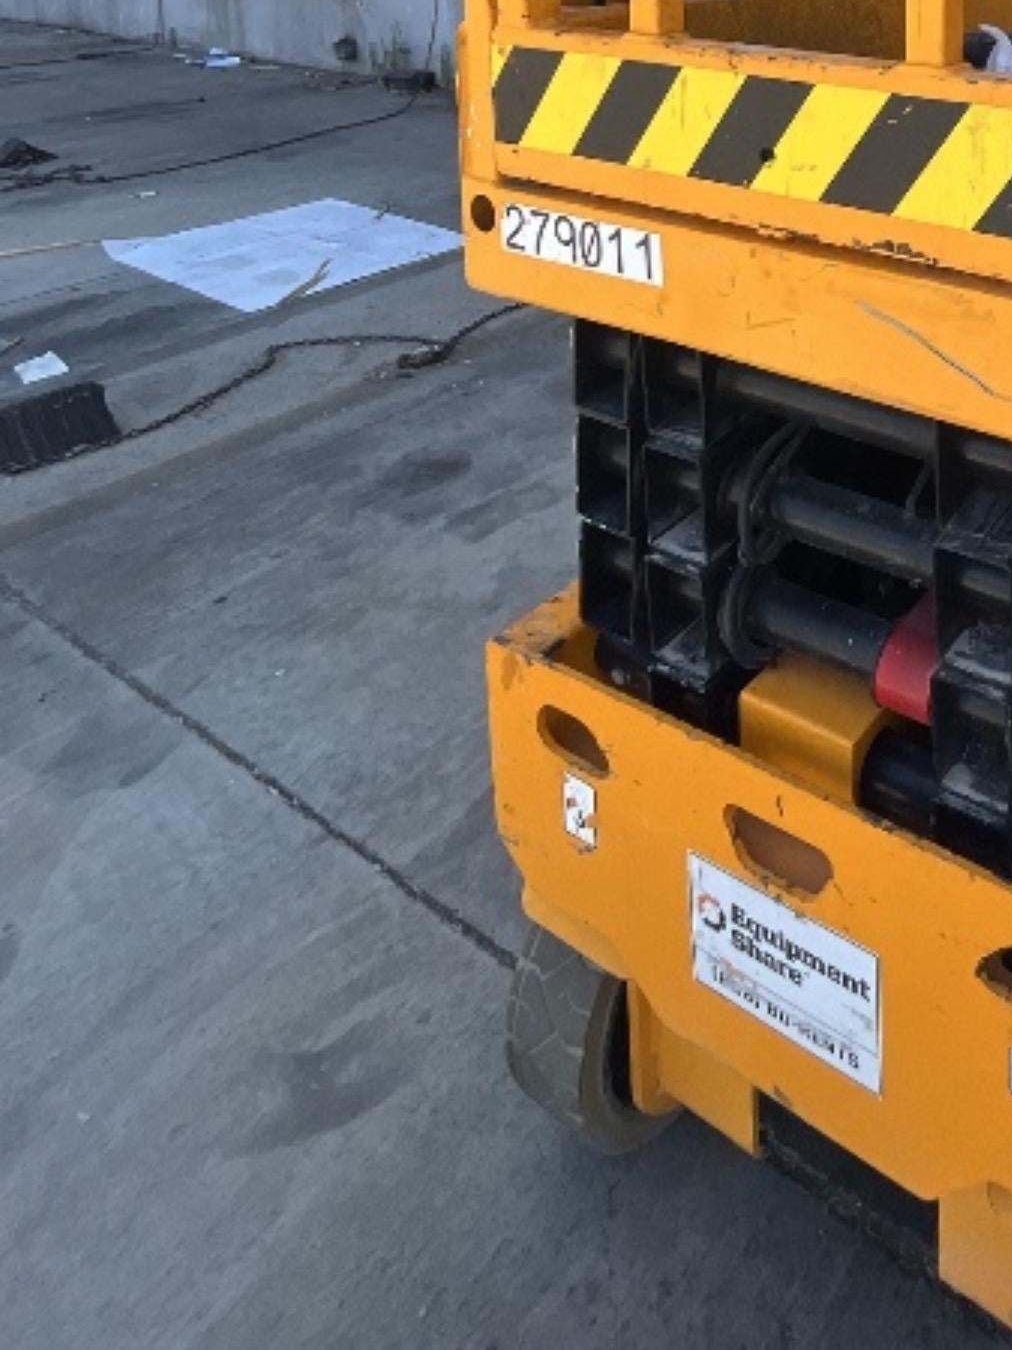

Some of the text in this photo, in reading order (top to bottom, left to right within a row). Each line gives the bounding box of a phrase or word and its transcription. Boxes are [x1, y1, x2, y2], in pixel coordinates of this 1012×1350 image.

[505, 205, 654, 280] 279011
[731, 902, 871, 1003] Equipment
[731, 929, 805, 987] Share
